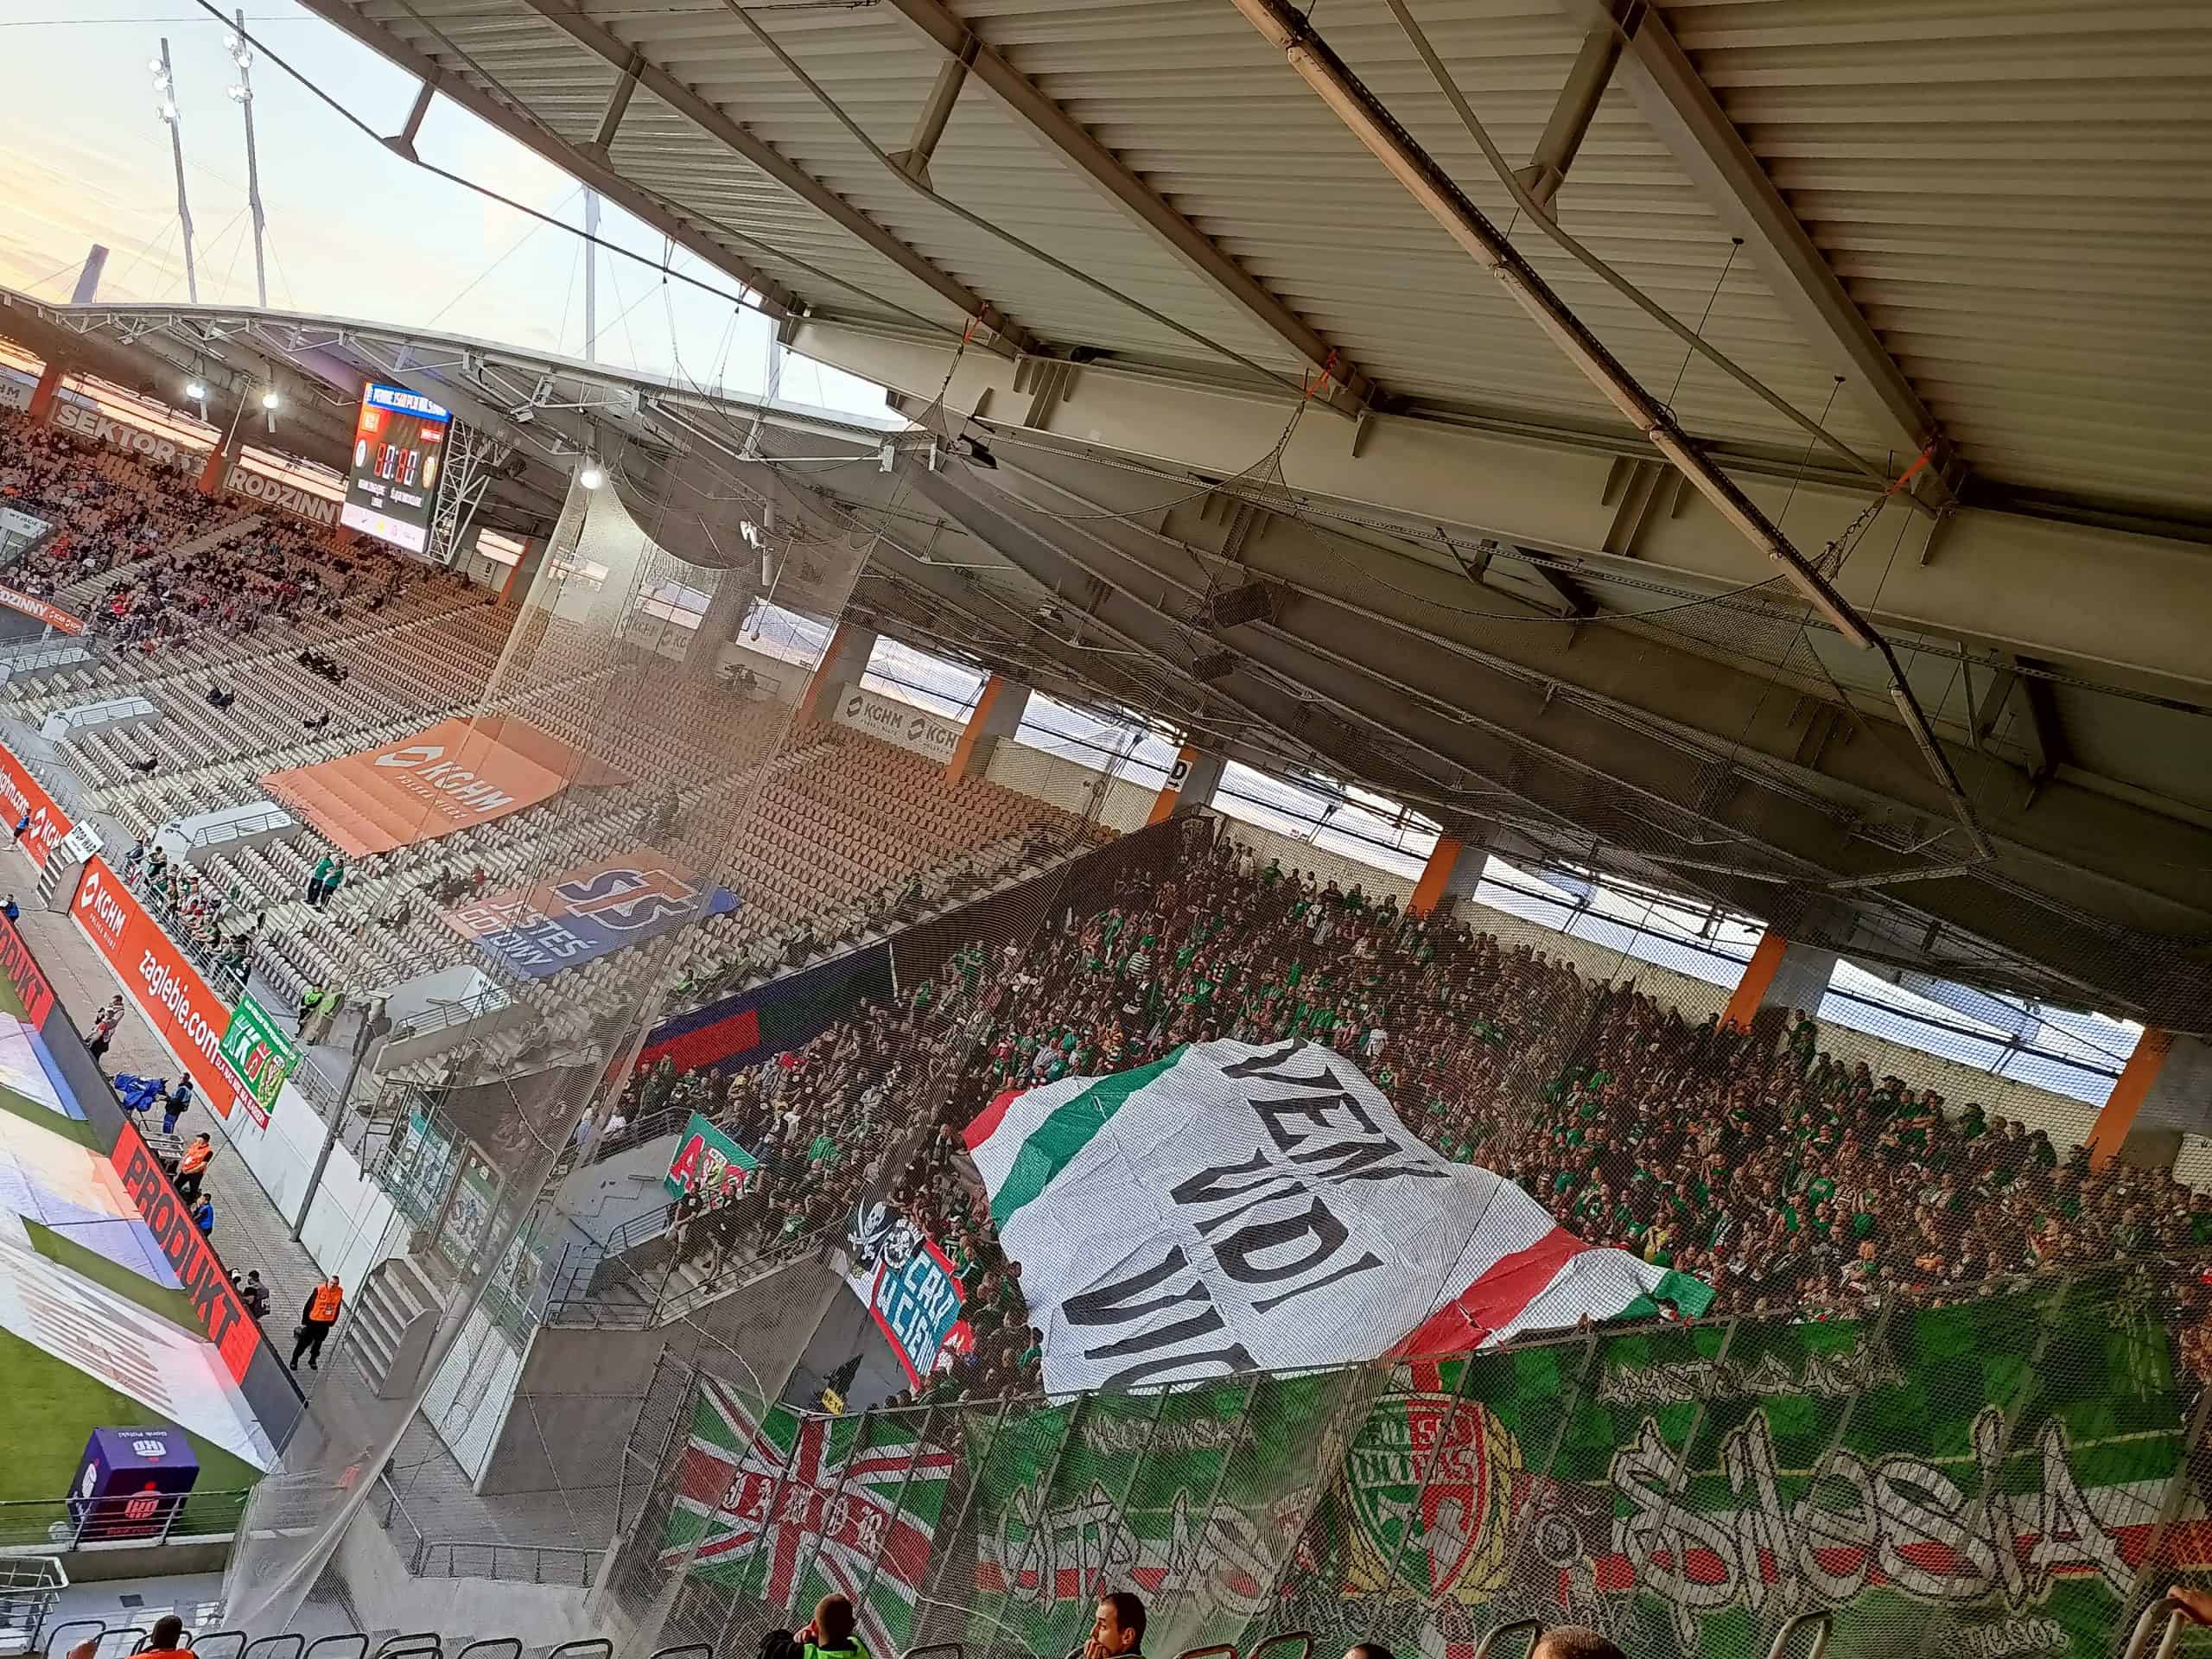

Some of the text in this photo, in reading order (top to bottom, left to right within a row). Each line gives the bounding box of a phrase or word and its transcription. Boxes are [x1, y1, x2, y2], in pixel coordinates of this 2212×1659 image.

[57, 404, 175, 463] SEKTOR
[227, 467, 342, 526] RODZINN
[864, 703, 904, 728] KGHM
[415, 760, 515, 813] KGHM
[1170, 760, 1188, 780] D
[94, 886, 127, 938] KGHM
[138, 949, 220, 1065] zaglebie.com
[1222, 1037, 1449, 1185] VENI
[124, 1143, 243, 1348] PRODUKT
[1170, 1147, 1383, 1314] VIDI
